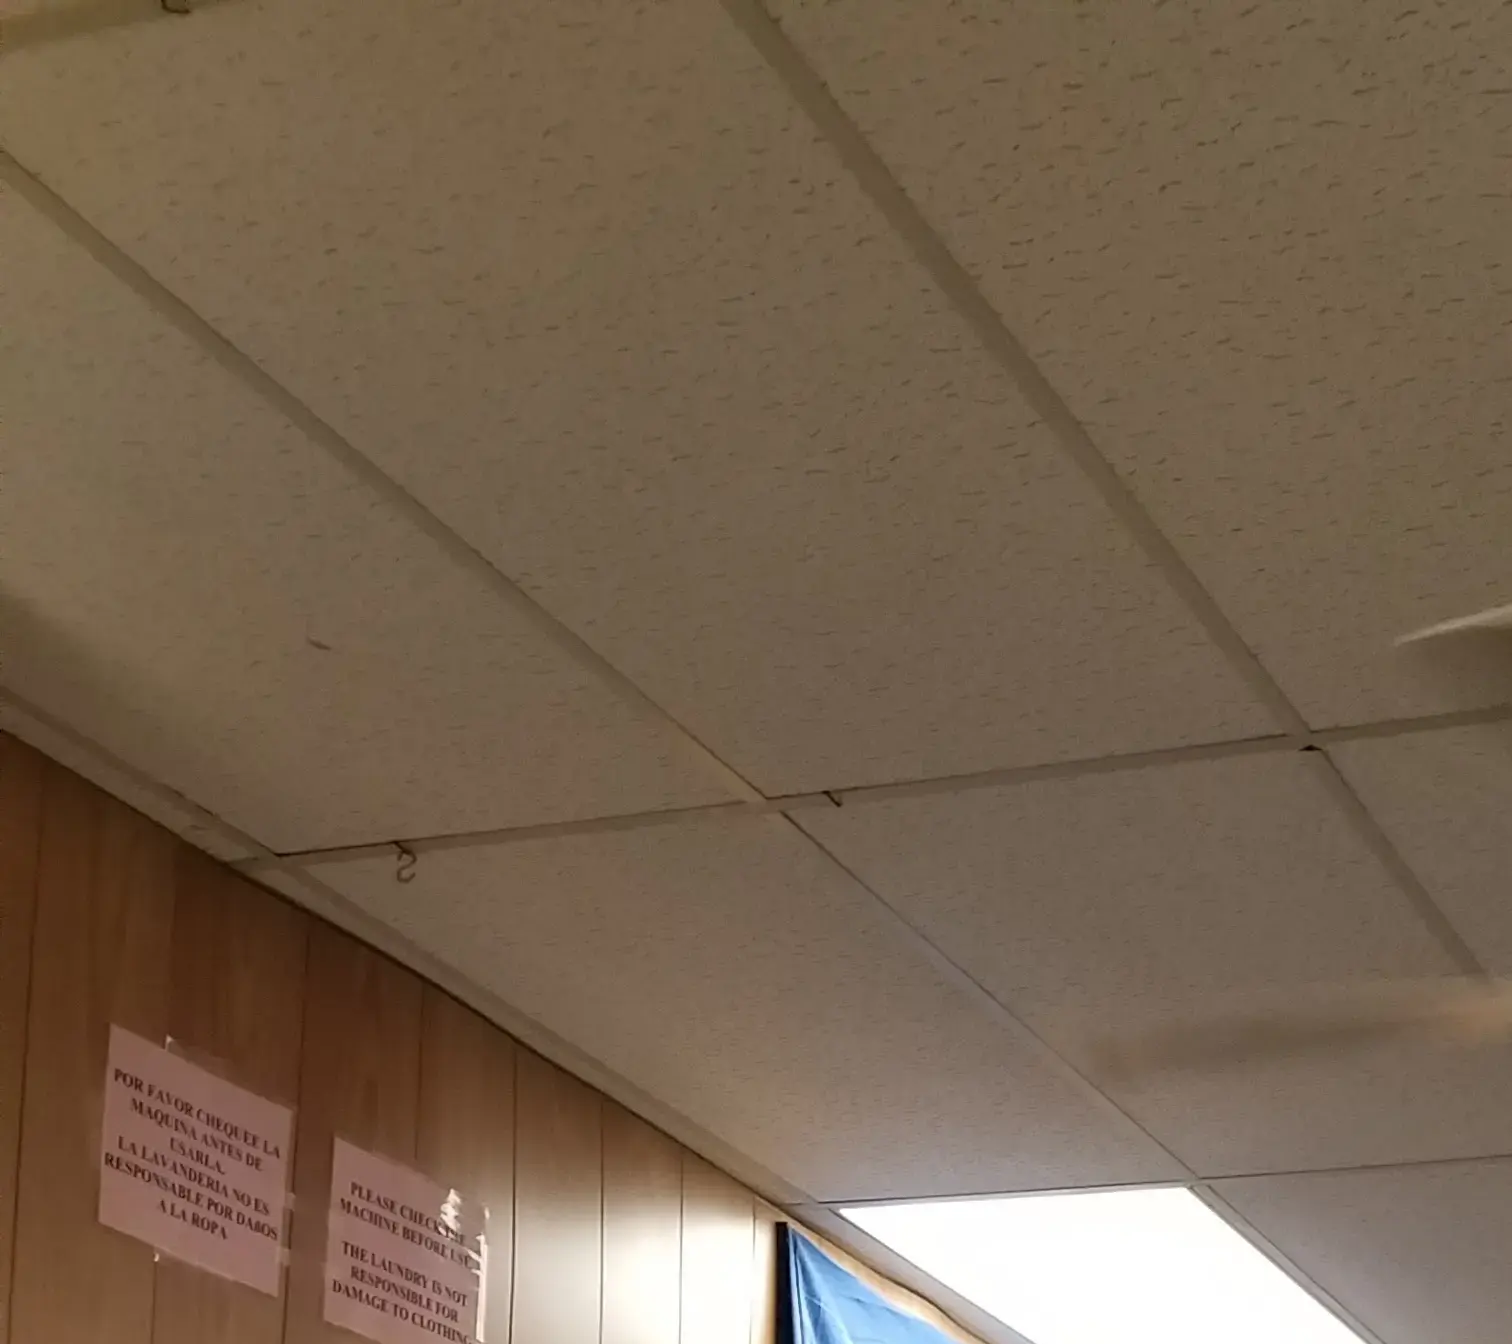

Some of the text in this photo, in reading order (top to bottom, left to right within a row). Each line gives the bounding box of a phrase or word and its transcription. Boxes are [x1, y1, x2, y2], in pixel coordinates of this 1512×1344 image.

[114, 1068, 281, 1159] POR FAVOR CHEQUEE LA
[131, 1098, 263, 1172] MAQUINA ANTES DE
[104, 1152, 204, 1208] RESPONSABLE
[207, 1199, 233, 1222] POR
[118, 1135, 271, 1216] LA LAVANDERIA NO ES
[158, 1199, 229, 1240] A LA ROPA
[340, 1198, 400, 1236] MACHINE
[402, 1225, 448, 1259] BEFORE
[351, 1182, 398, 1215] PLEASE
[400, 1204, 445, 1234] CHECK
[332, 1279, 390, 1313] DAMAGE
[392, 1303, 409, 1321] TO
[341, 1240, 469, 1308] THE LAUNDRY IS NOT
[350, 1266, 460, 1323] RESPONSIBLE FOR
